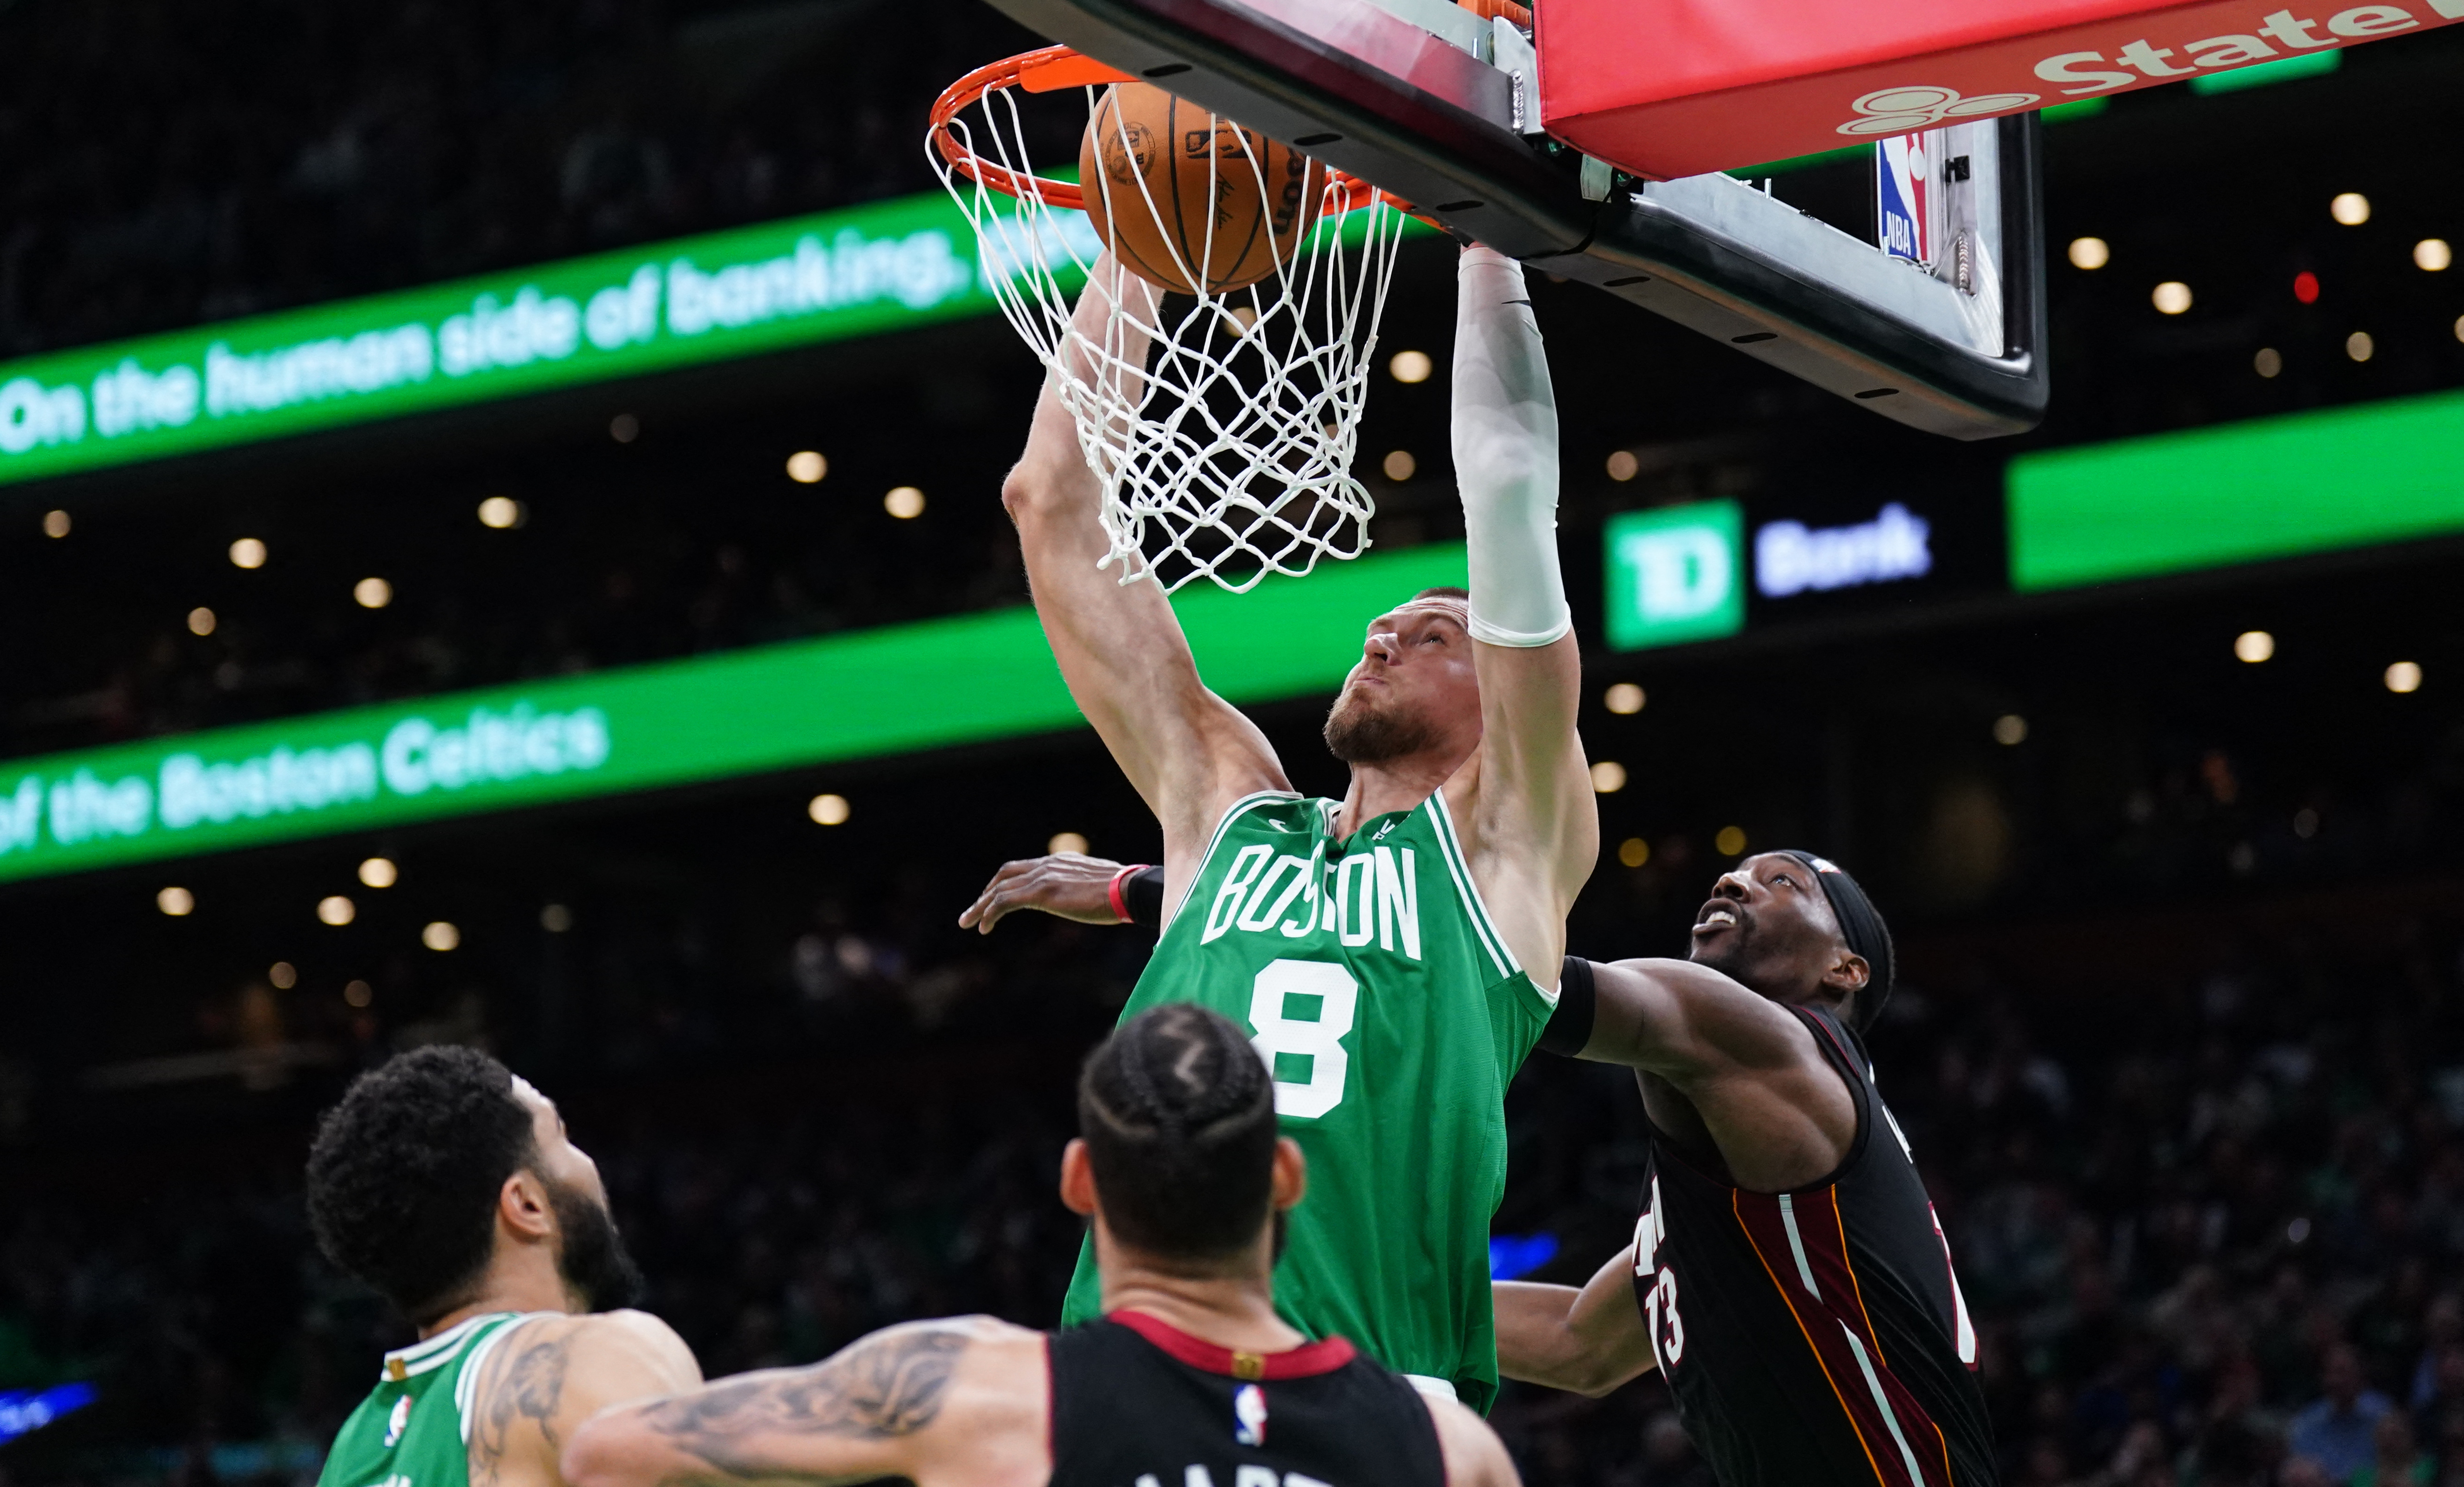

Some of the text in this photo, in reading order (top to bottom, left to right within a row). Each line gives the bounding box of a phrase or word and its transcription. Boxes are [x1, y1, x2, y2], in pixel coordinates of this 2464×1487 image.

[2034, 5, 2420, 95] State
[1886, 211, 1910, 255] NBA
[0, 378, 87, 453] On
[92, 356, 200, 437] the
[205, 322, 433, 415] human
[438, 285, 580, 375] side
[584, 263, 662, 348] of
[667, 229, 970, 334] banking.
[1618, 504, 1931, 625] TD Bank
[48, 767, 153, 843] the
[158, 743, 378, 828] Boston
[381, 702, 608, 794] Celtics
[1200, 839, 1422, 961] BOSTON
[1249, 958, 1359, 1119] 8
[1645, 1264, 1684, 1381] 13
